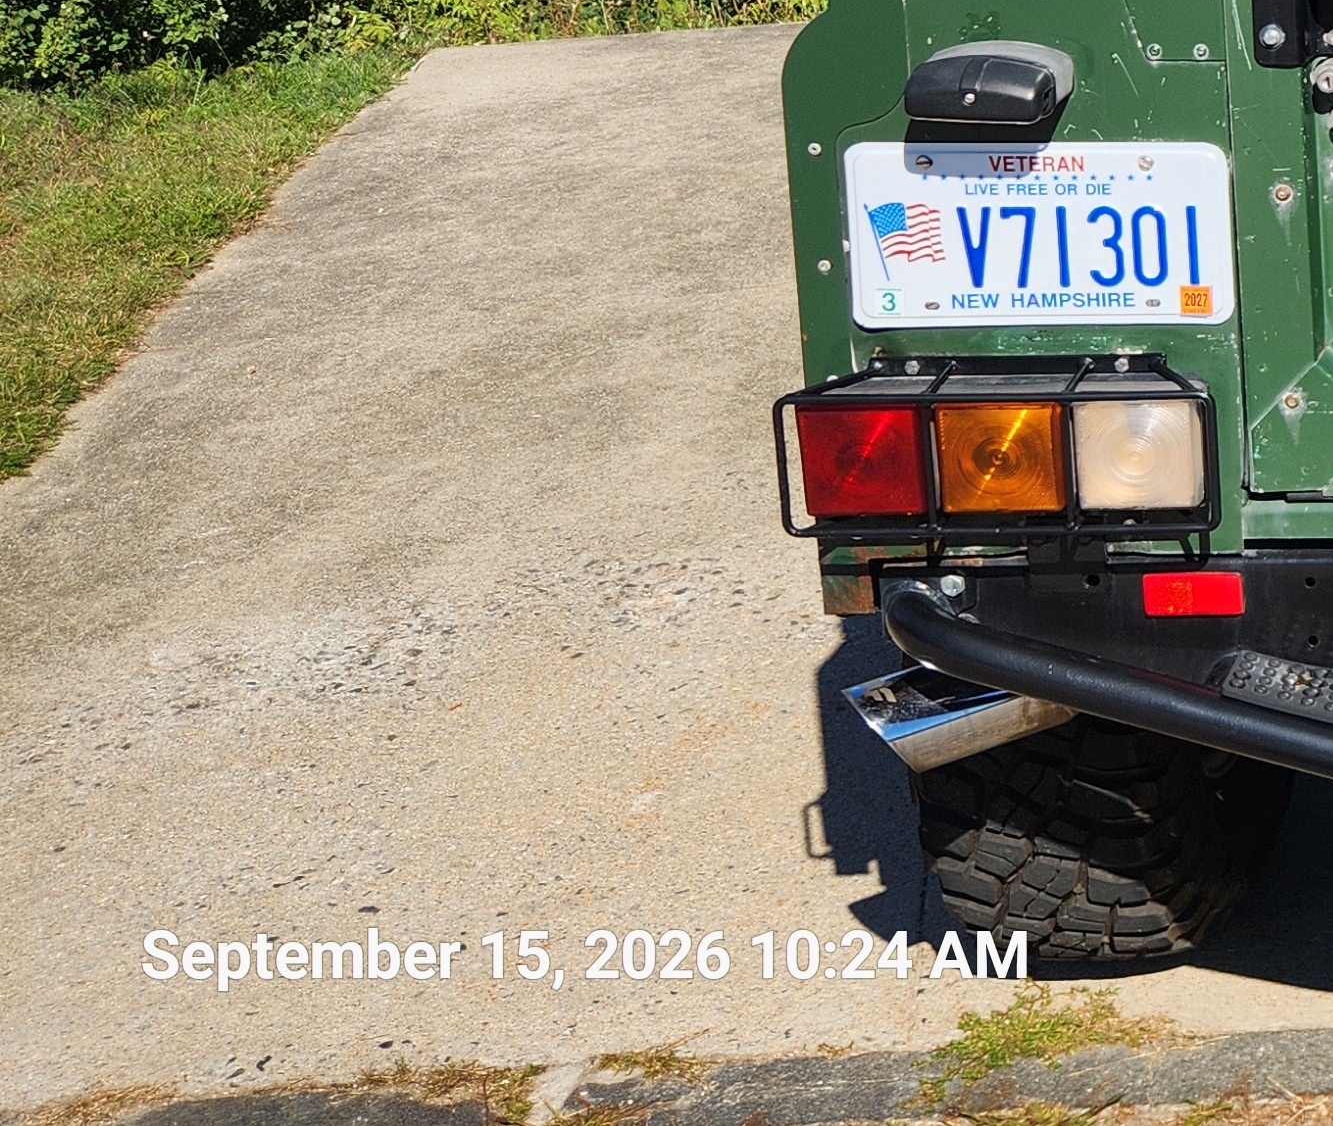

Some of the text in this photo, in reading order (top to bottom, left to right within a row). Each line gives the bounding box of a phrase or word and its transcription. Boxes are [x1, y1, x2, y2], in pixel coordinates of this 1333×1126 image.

[988, 155, 1084, 172] VETERAN
[965, 184, 1111, 195] LIVE FREE OR DIE
[956, 205, 1201, 288] V71301
[881, 292, 896, 312] 3
[952, 292, 1136, 309] NEW HAMPSHIRE
[1183, 292, 1208, 308] 2027
